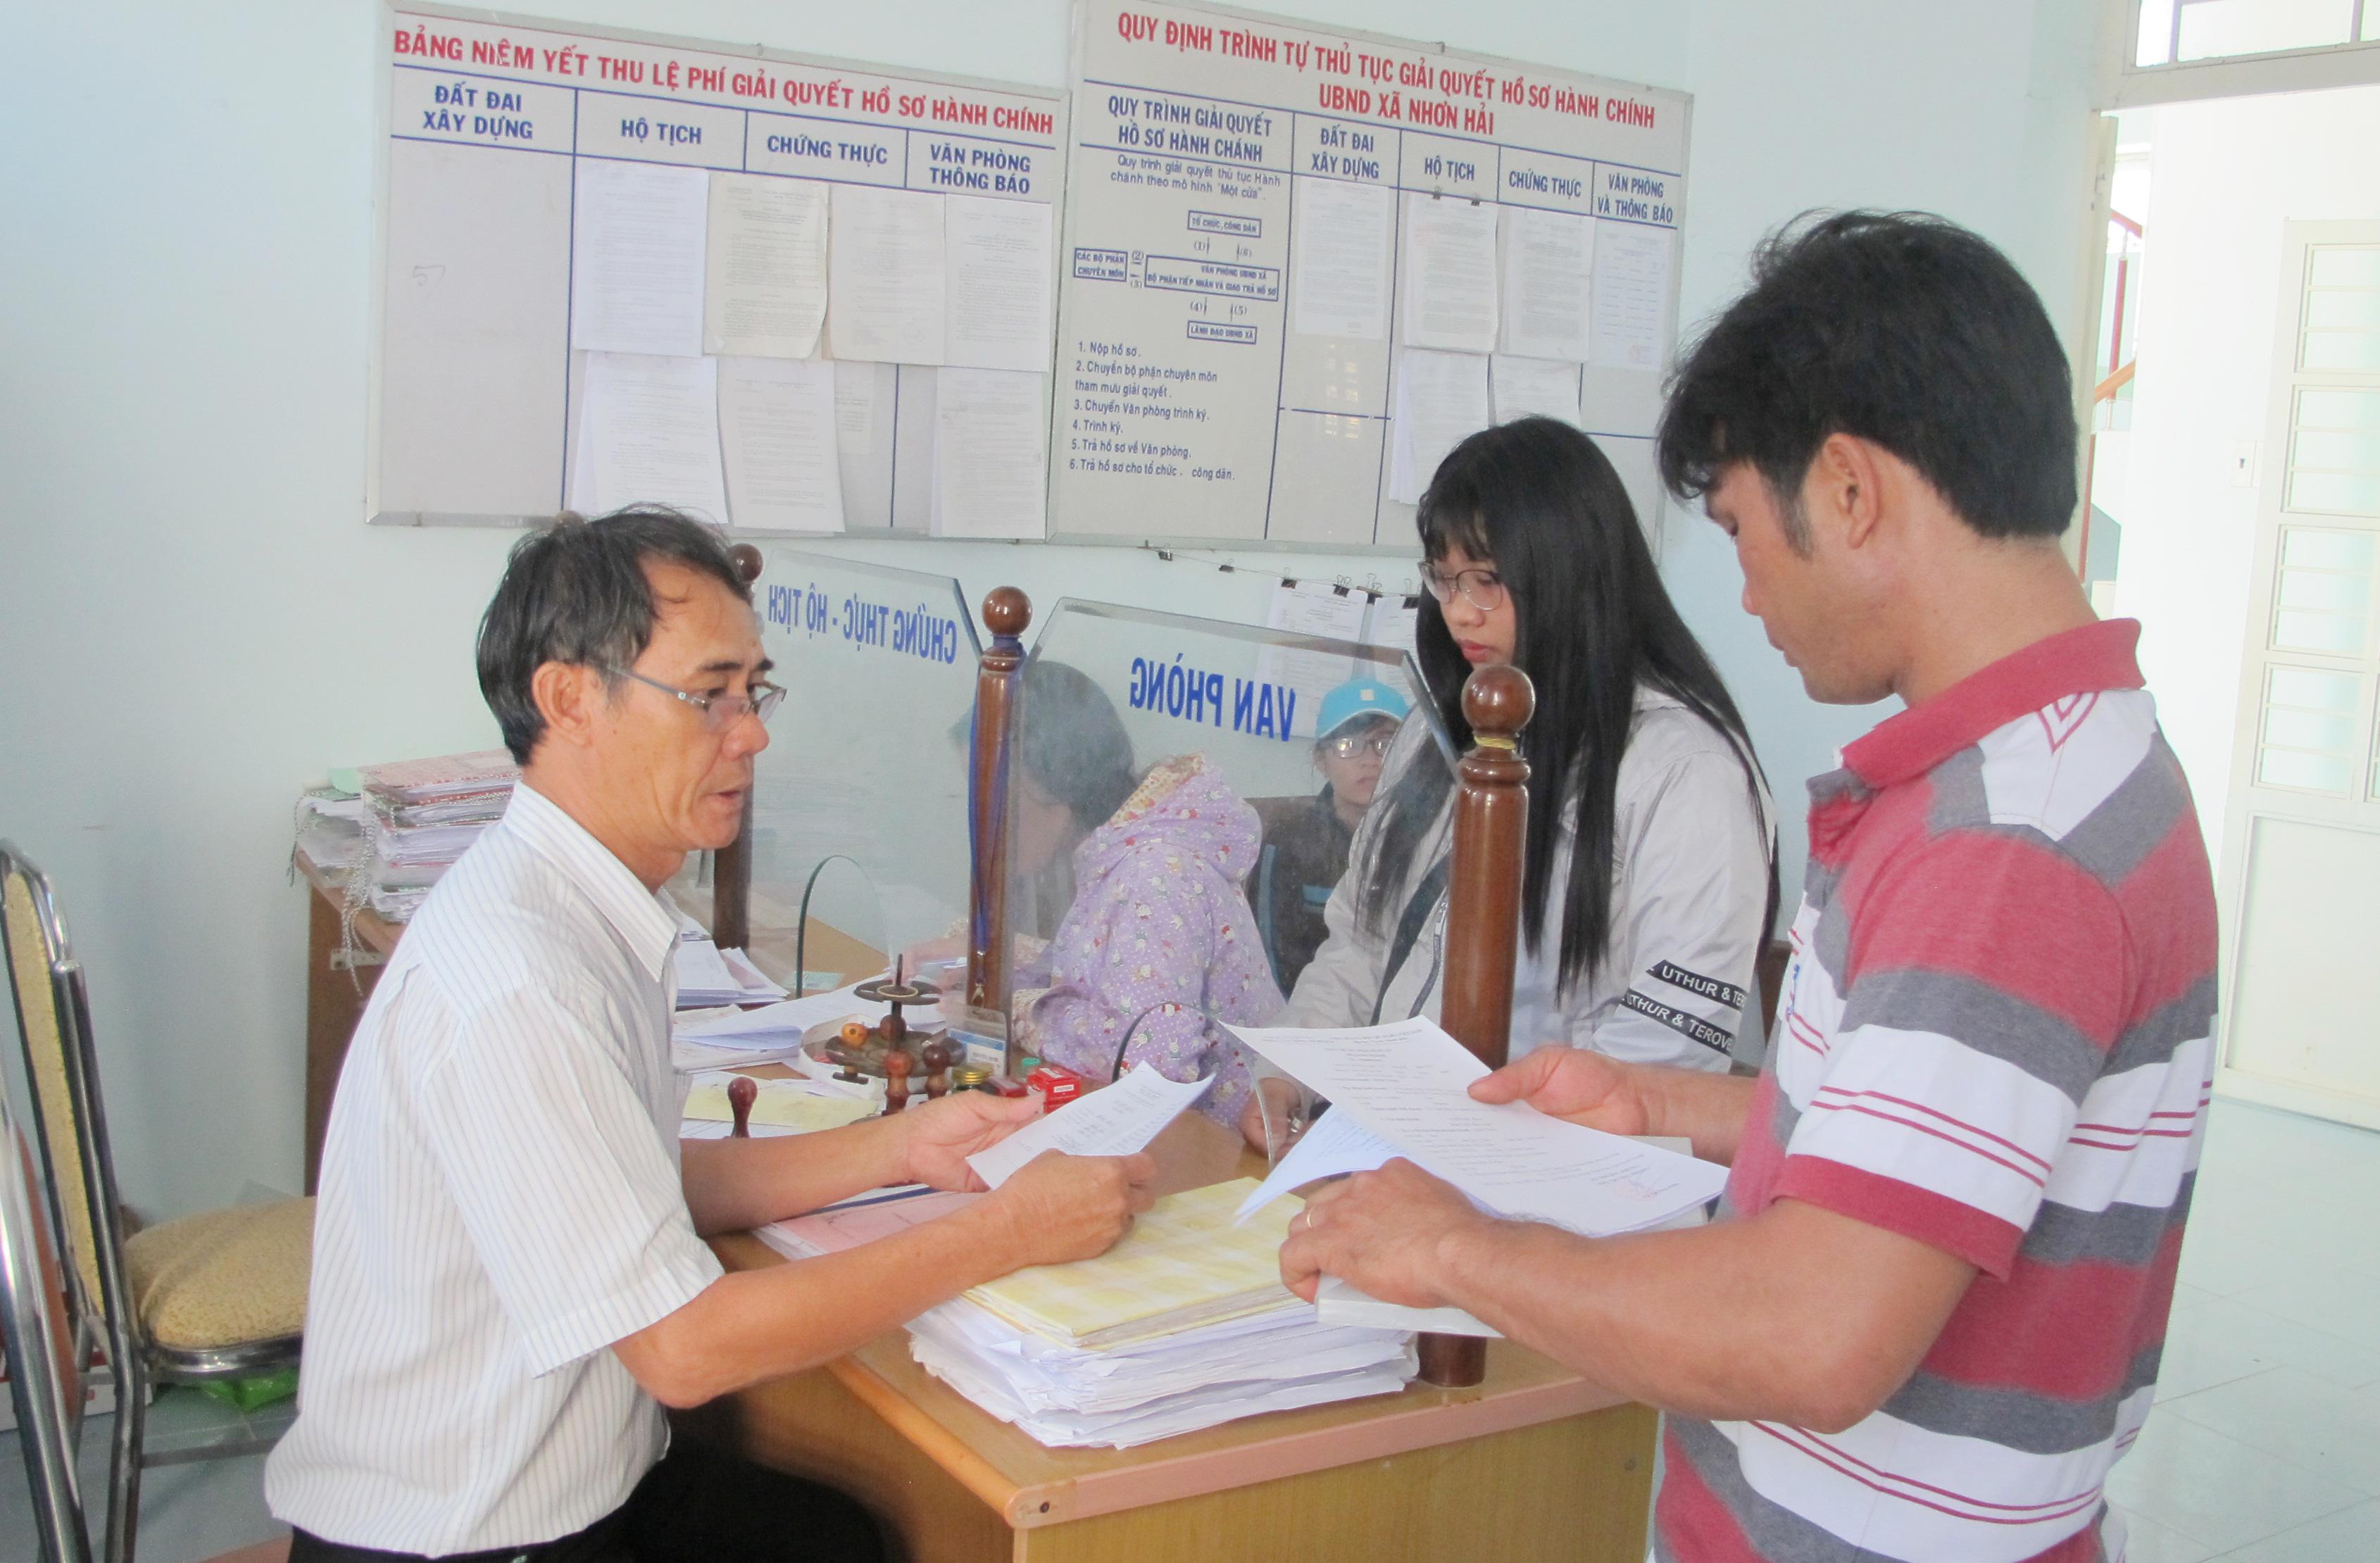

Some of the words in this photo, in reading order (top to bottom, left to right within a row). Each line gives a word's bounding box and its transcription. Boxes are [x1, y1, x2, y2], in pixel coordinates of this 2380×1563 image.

[394, 25, 463, 62] BẢNG
[544, 44, 589, 76] YẾT
[598, 56, 643, 82] THU
[653, 61, 679, 92] LỆ
[688, 65, 725, 92] PHÍ
[732, 68, 775, 99] GIẢI
[784, 79, 853, 109] QUYẾT
[862, 85, 891, 114] HỒ
[898, 95, 927, 118] SƠ
[932, 98, 987, 125] HÀNH
[994, 106, 1053, 134] CHÍNH
[1118, 12, 1158, 43] QUY
[1165, 20, 1213, 52] ĐỊNH
[1220, 29, 1277, 63] TRÌNH
[1284, 42, 1309, 72] TỰ
[1315, 42, 1351, 75] THỦ
[1358, 54, 1393, 84] TỤC
[1400, 57, 1433, 89] GIẢI
[1440, 69, 1495, 101] QUYẾT
[1502, 75, 1524, 106] HỒ
[1529, 84, 1552, 110] SƠ
[1555, 87, 1598, 118] HÀNH
[1606, 97, 1655, 129] CHÍNH
[434, 82, 477, 107] ĐẤT
[487, 92, 522, 112] ĐAI
[1320, 83, 1370, 114] UBND
[1378, 92, 1401, 120] XÃ
[1408, 99, 1458, 130] NHƠN
[1464, 103, 1494, 136] HẢI
[422, 109, 465, 132] XÂY
[474, 115, 533, 141] DỰNG
[1108, 96, 1139, 118] QUY
[1144, 99, 1191, 125] TRÌNH
[1195, 105, 1222, 130] GIẢI
[1227, 111, 1272, 137] QUYẾT
[621, 117, 647, 144] HỘ
[658, 123, 701, 147] TỊCH
[1118, 119, 1139, 145] HỒ
[1144, 127, 1165, 148] SƠ
[1170, 130, 1209, 155] HÀNH
[1215, 139, 1263, 163] CHÁNH
[1320, 125, 1347, 148] ĐẤT
[1352, 133, 1374, 153] ĐAI
[768, 134, 832, 159] CHỨNG
[840, 143, 887, 168] THỰC
[930, 144, 969, 165] VĂN
[972, 149, 1031, 172] PHÒNG
[930, 166, 989, 190] THÔNG
[995, 170, 1030, 194] BÁO
[1312, 151, 1338, 173] XÂY
[1343, 156, 1379, 181] DỰNG
[1424, 155, 1441, 180] HỘ
[1446, 161, 1475, 183] TỊCH
[1148, 175, 1168, 187] theo
[1509, 168, 1548, 192] CHỨNG
[1551, 177, 1582, 200] THỰC
[1598, 194, 1610, 214] VÀ
[1615, 199, 1647, 219] THÔNG
[1653, 203, 1673, 223] BÁO
[1079, 341, 1085, 352] 1.
[1090, 342, 1108, 357] Nộp
[1076, 360, 1084, 372] 2.
[1075, 380, 1098, 391] tham
[1074, 399, 1082, 410] 3.
[1072, 419, 1081, 430] 4.
[1072, 439, 1079, 450] 5.
[1070, 458, 1078, 470] 6.
[1126, 463, 1142, 474] cho
[1721, 987, 1731, 1001] &
[1672, 1014, 1683, 1027] &
